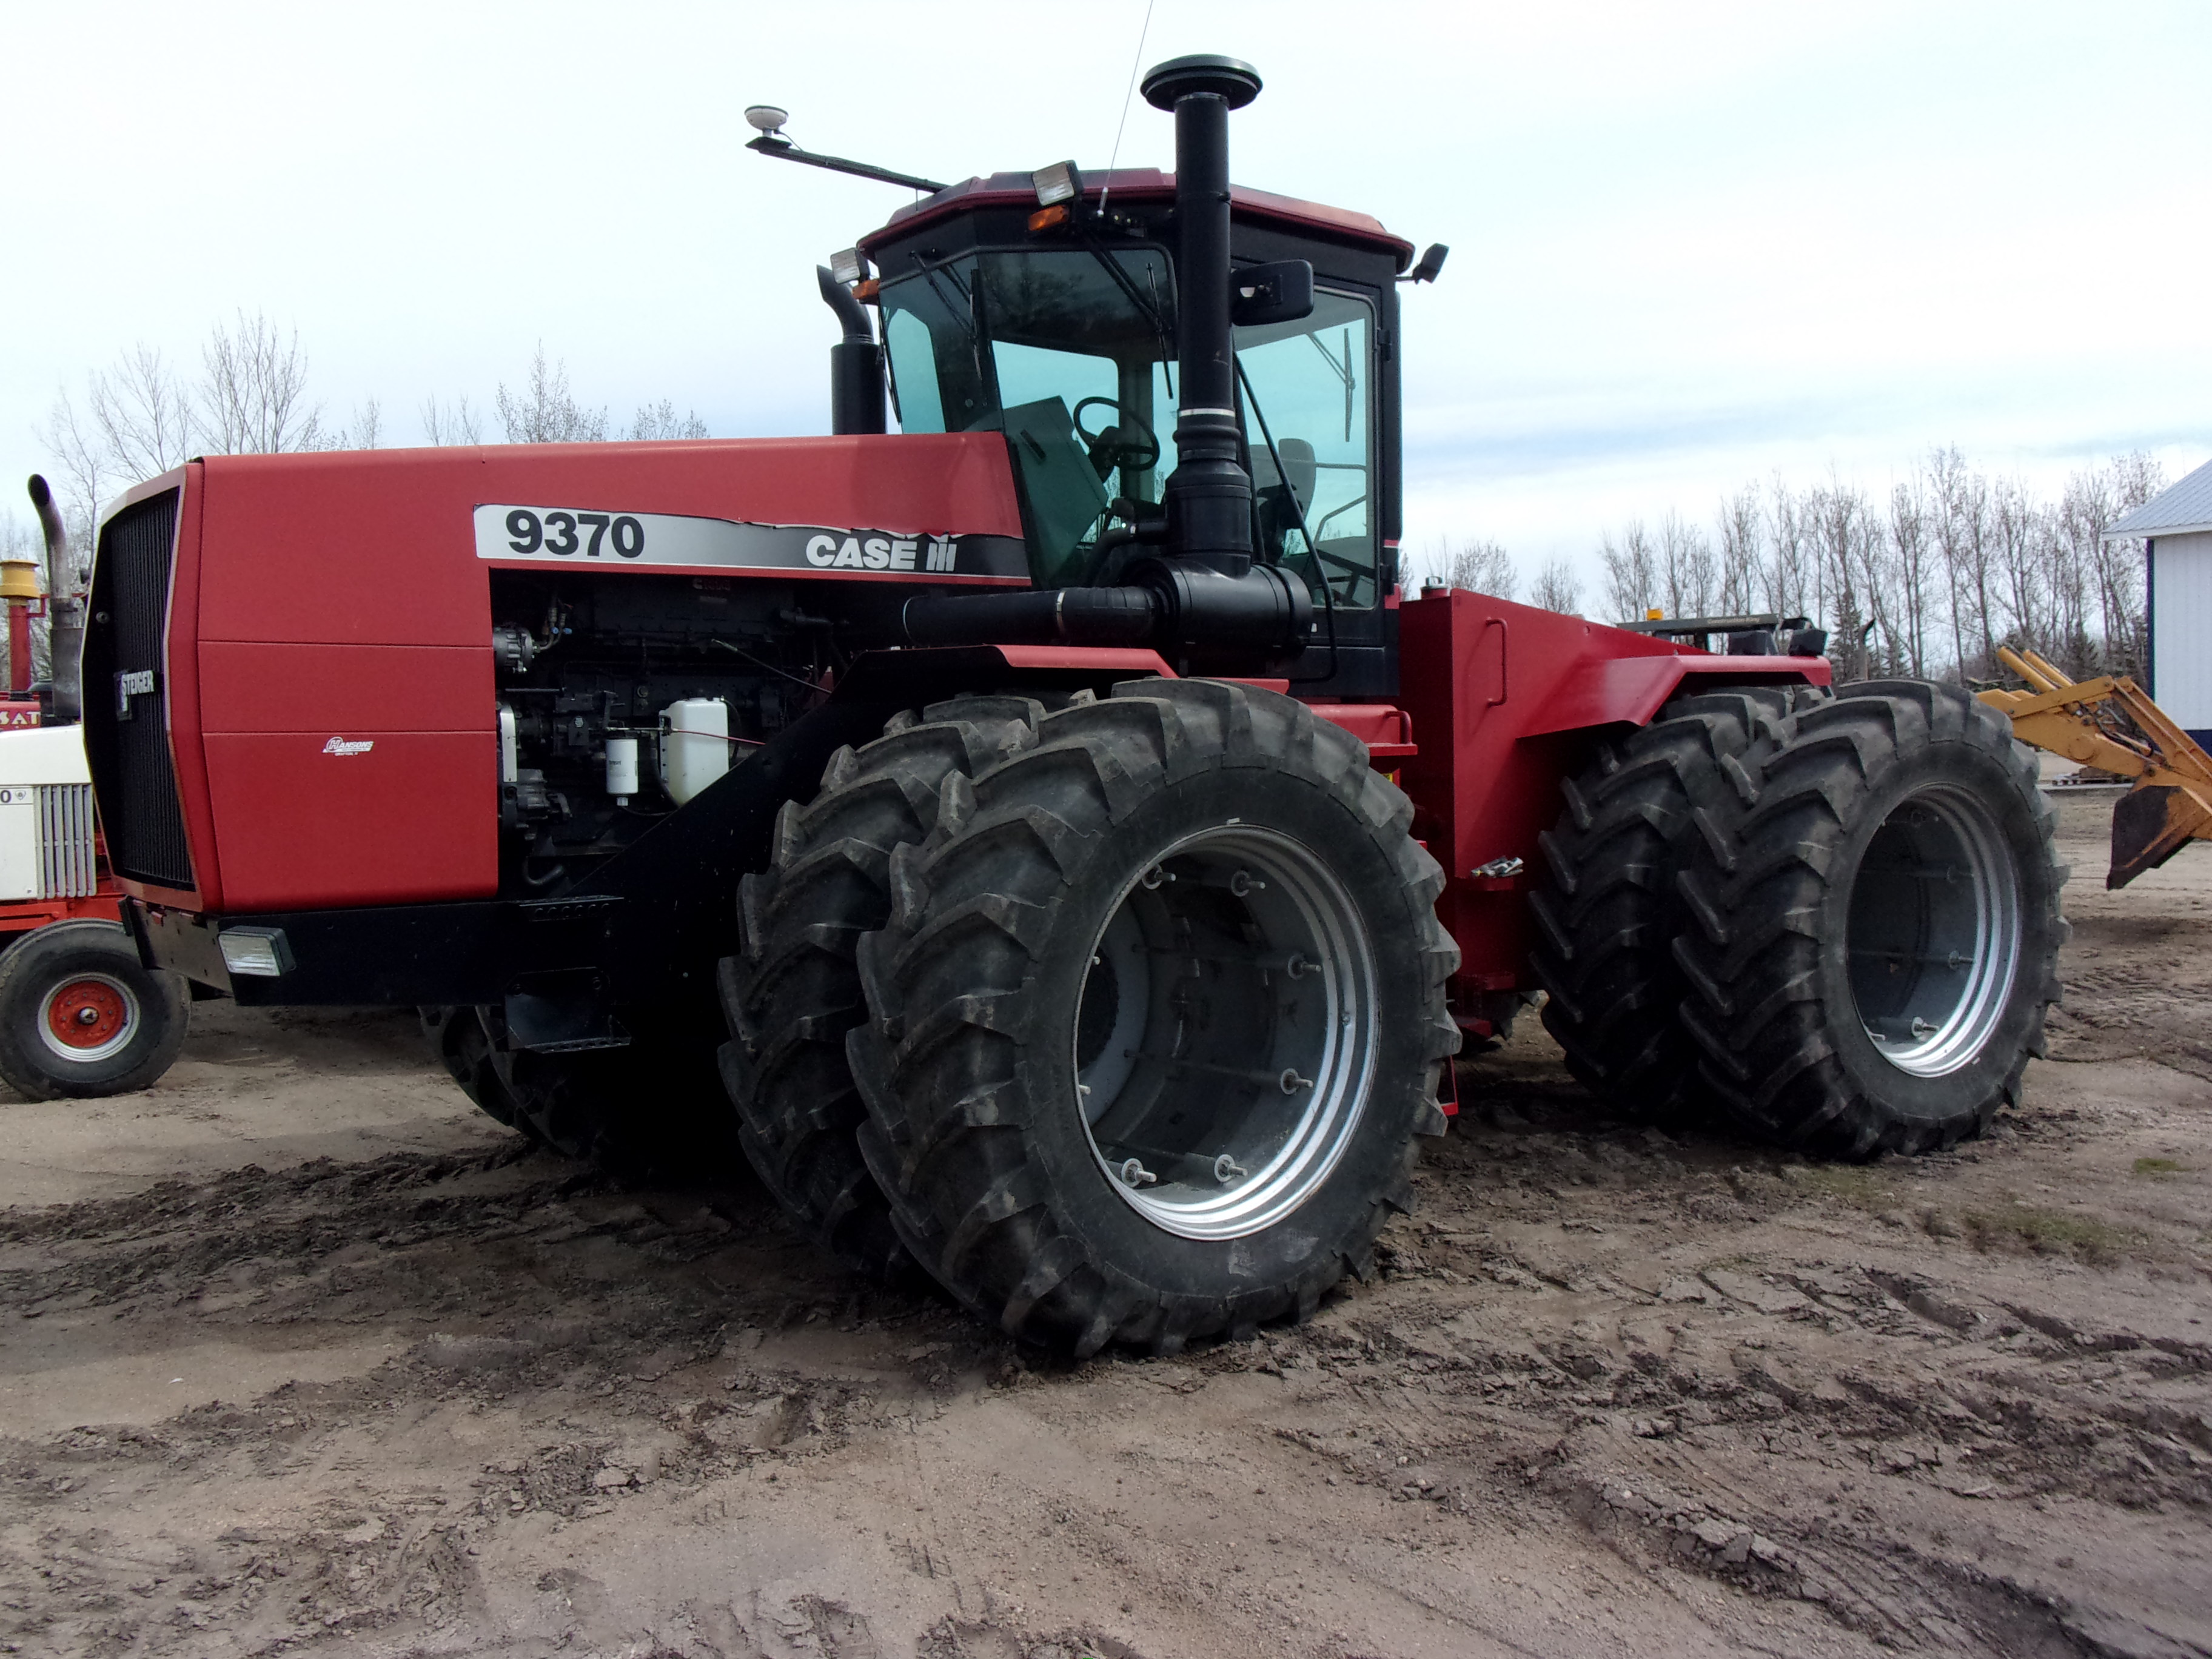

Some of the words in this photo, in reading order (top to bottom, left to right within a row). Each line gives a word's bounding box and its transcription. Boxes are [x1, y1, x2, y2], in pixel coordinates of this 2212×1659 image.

[506, 509, 645, 558] 9370
[806, 535, 917, 569] CASE
[121, 670, 155, 696] STEIGER
[328, 739, 374, 749] HANSONS
